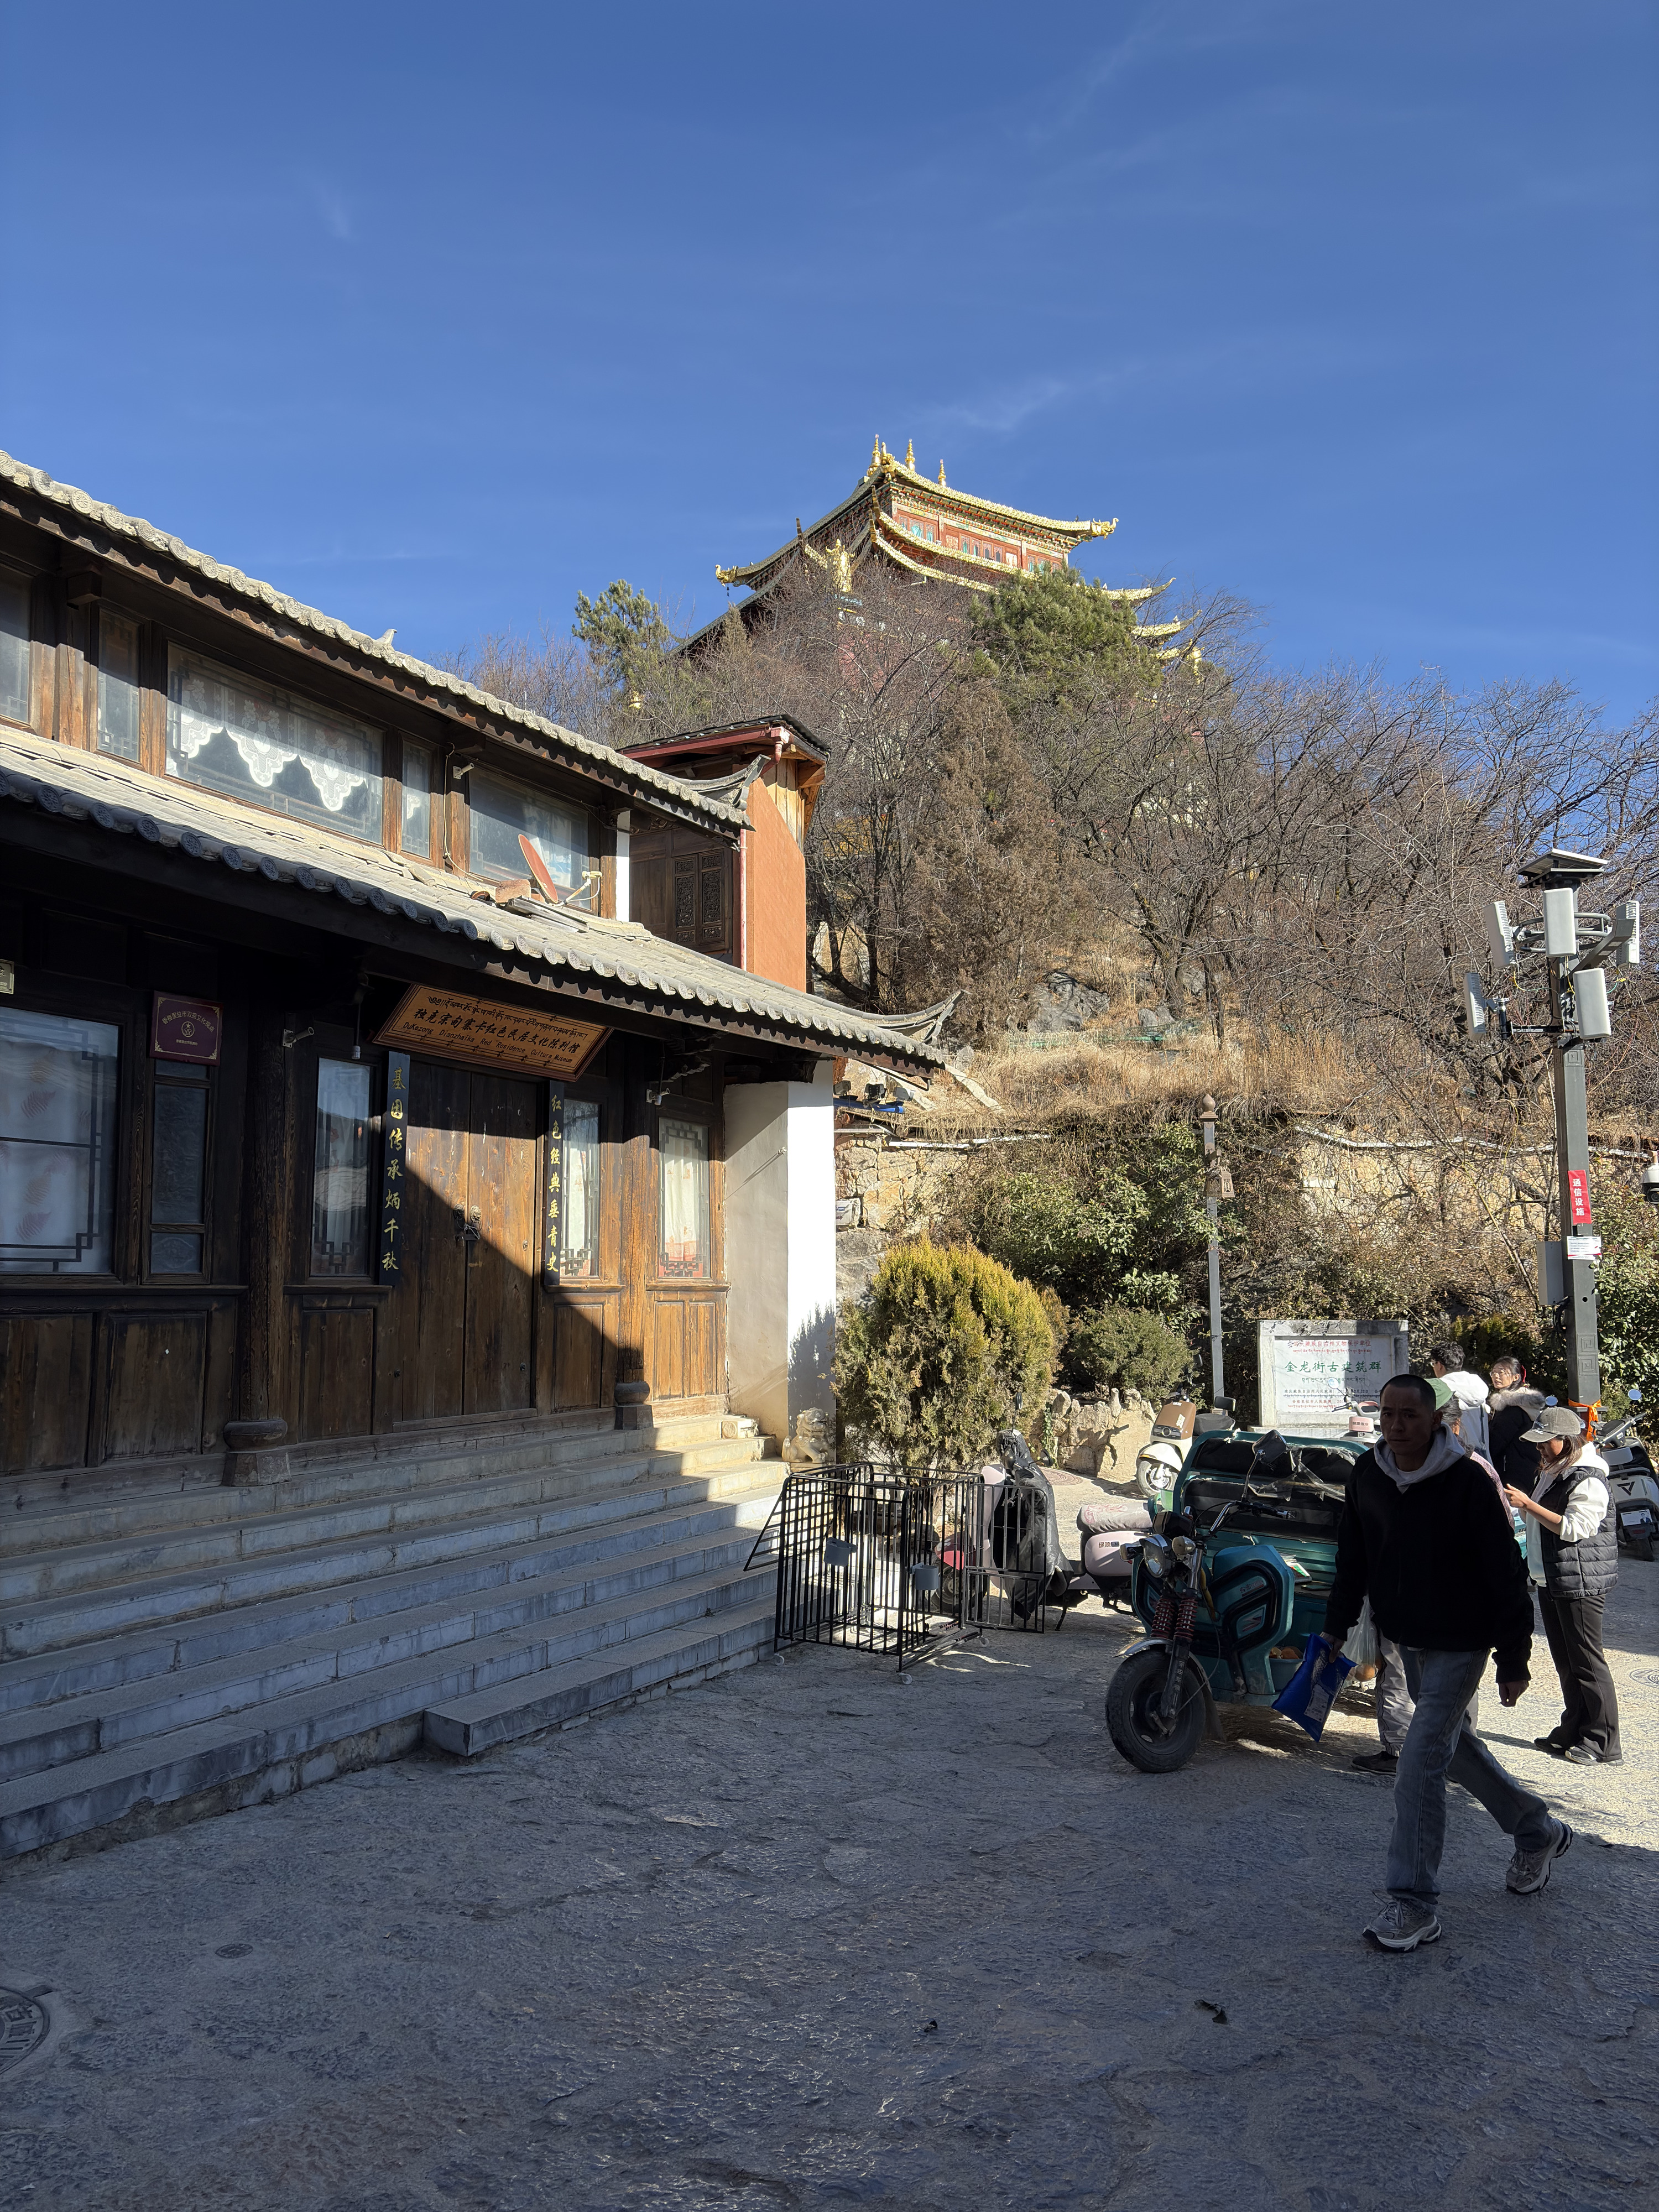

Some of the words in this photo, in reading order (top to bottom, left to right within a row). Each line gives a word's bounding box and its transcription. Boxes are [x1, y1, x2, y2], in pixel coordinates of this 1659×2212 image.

[403, 1021, 434, 1035] DuKezong
[439, 1030, 474, 1043] Dianzhaika
[481, 1037, 491, 1046] Red
[496, 1040, 526, 1053] Residence
[530, 1049, 552, 1059] Culture
[554, 1053, 573, 1063] Museum
[413, 1008, 581, 1053] 独克宗甸寨卡红色民居文化陈列馆
[381, 1066, 406, 1271] 基因传承炳千秋
[546, 1094, 562, 1272] 红色经典垂青史
[1573, 1178, 1585, 1216] 通信设施
[1285, 1360, 1381, 1373] 金龙街古建筑群
